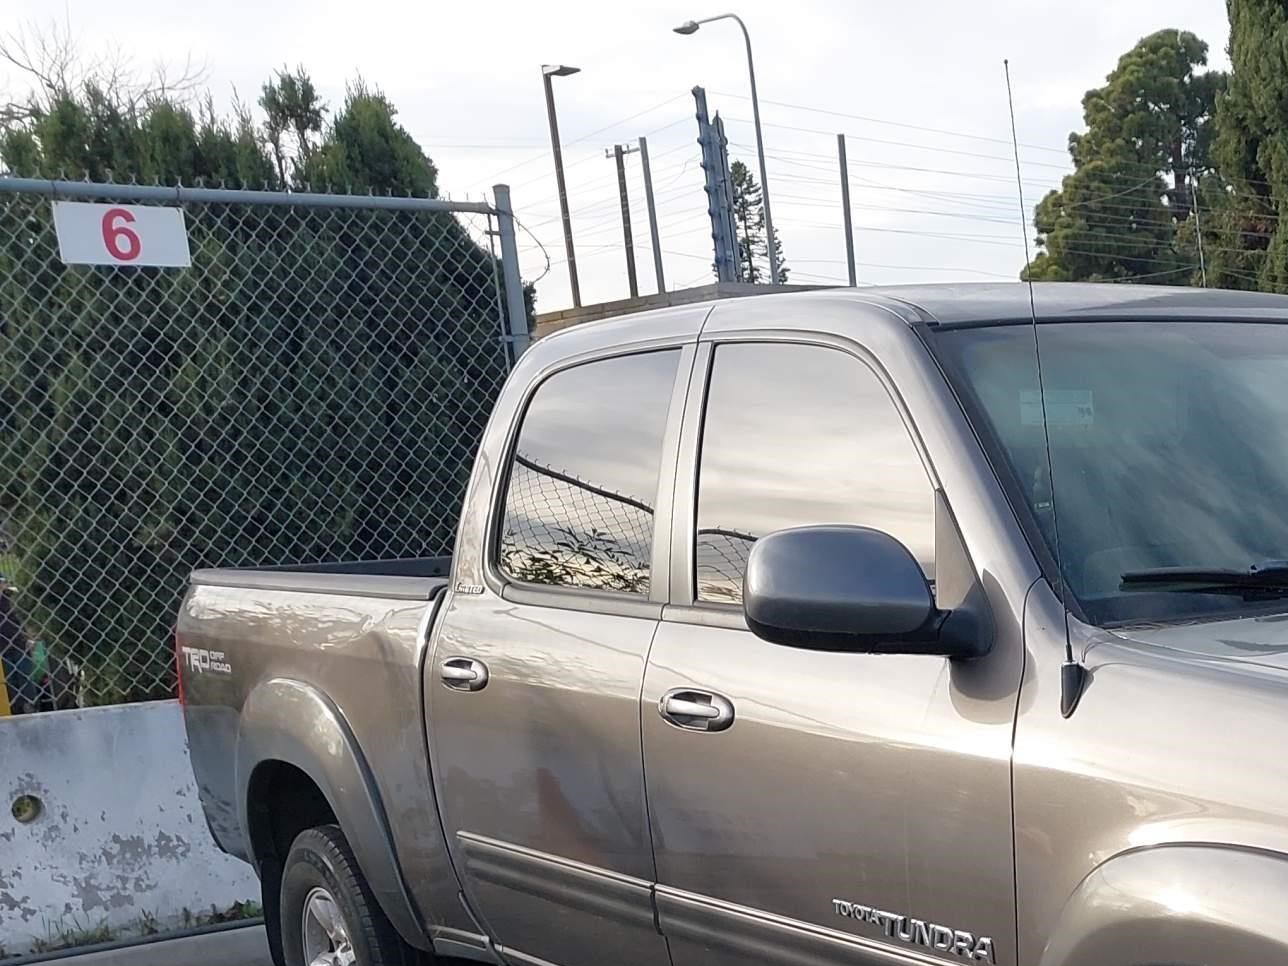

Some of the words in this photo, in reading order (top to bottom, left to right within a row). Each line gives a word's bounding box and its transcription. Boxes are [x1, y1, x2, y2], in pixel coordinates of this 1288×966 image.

[102, 208, 142, 261] 6
[182, 646, 210, 673] TRD
[210, 650, 225, 661] OFF
[210, 661, 232, 673] ROAD
[832, 899, 881, 925] TOYOTA
[876, 910, 997, 965] TUNDRA
